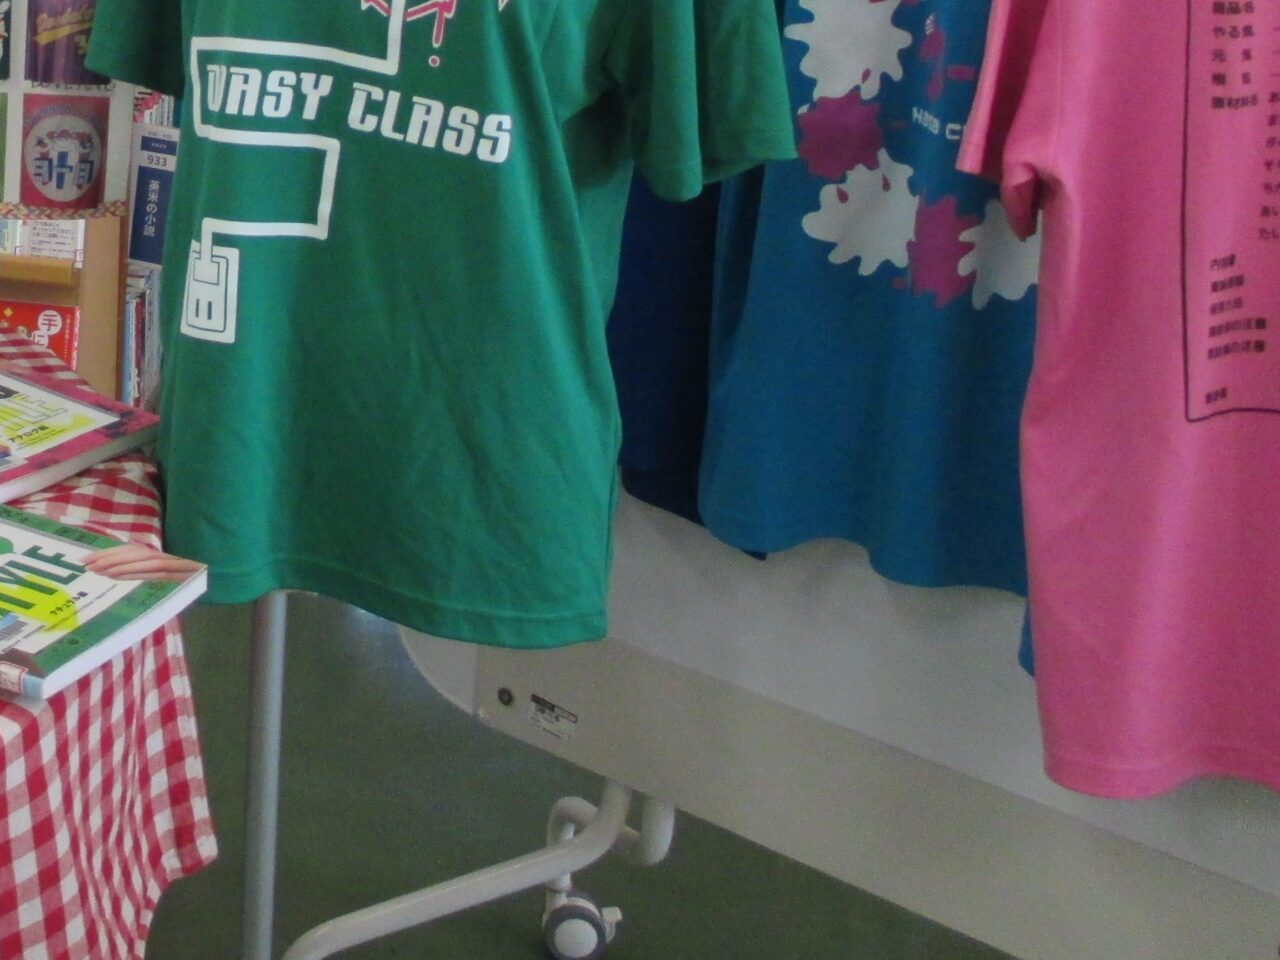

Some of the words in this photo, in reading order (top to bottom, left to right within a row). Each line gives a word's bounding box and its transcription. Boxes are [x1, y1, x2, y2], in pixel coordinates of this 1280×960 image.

[347, 82, 513, 163] CLASS
[147, 154, 168, 167] 933
[143, 179, 161, 237] 英米の小説
